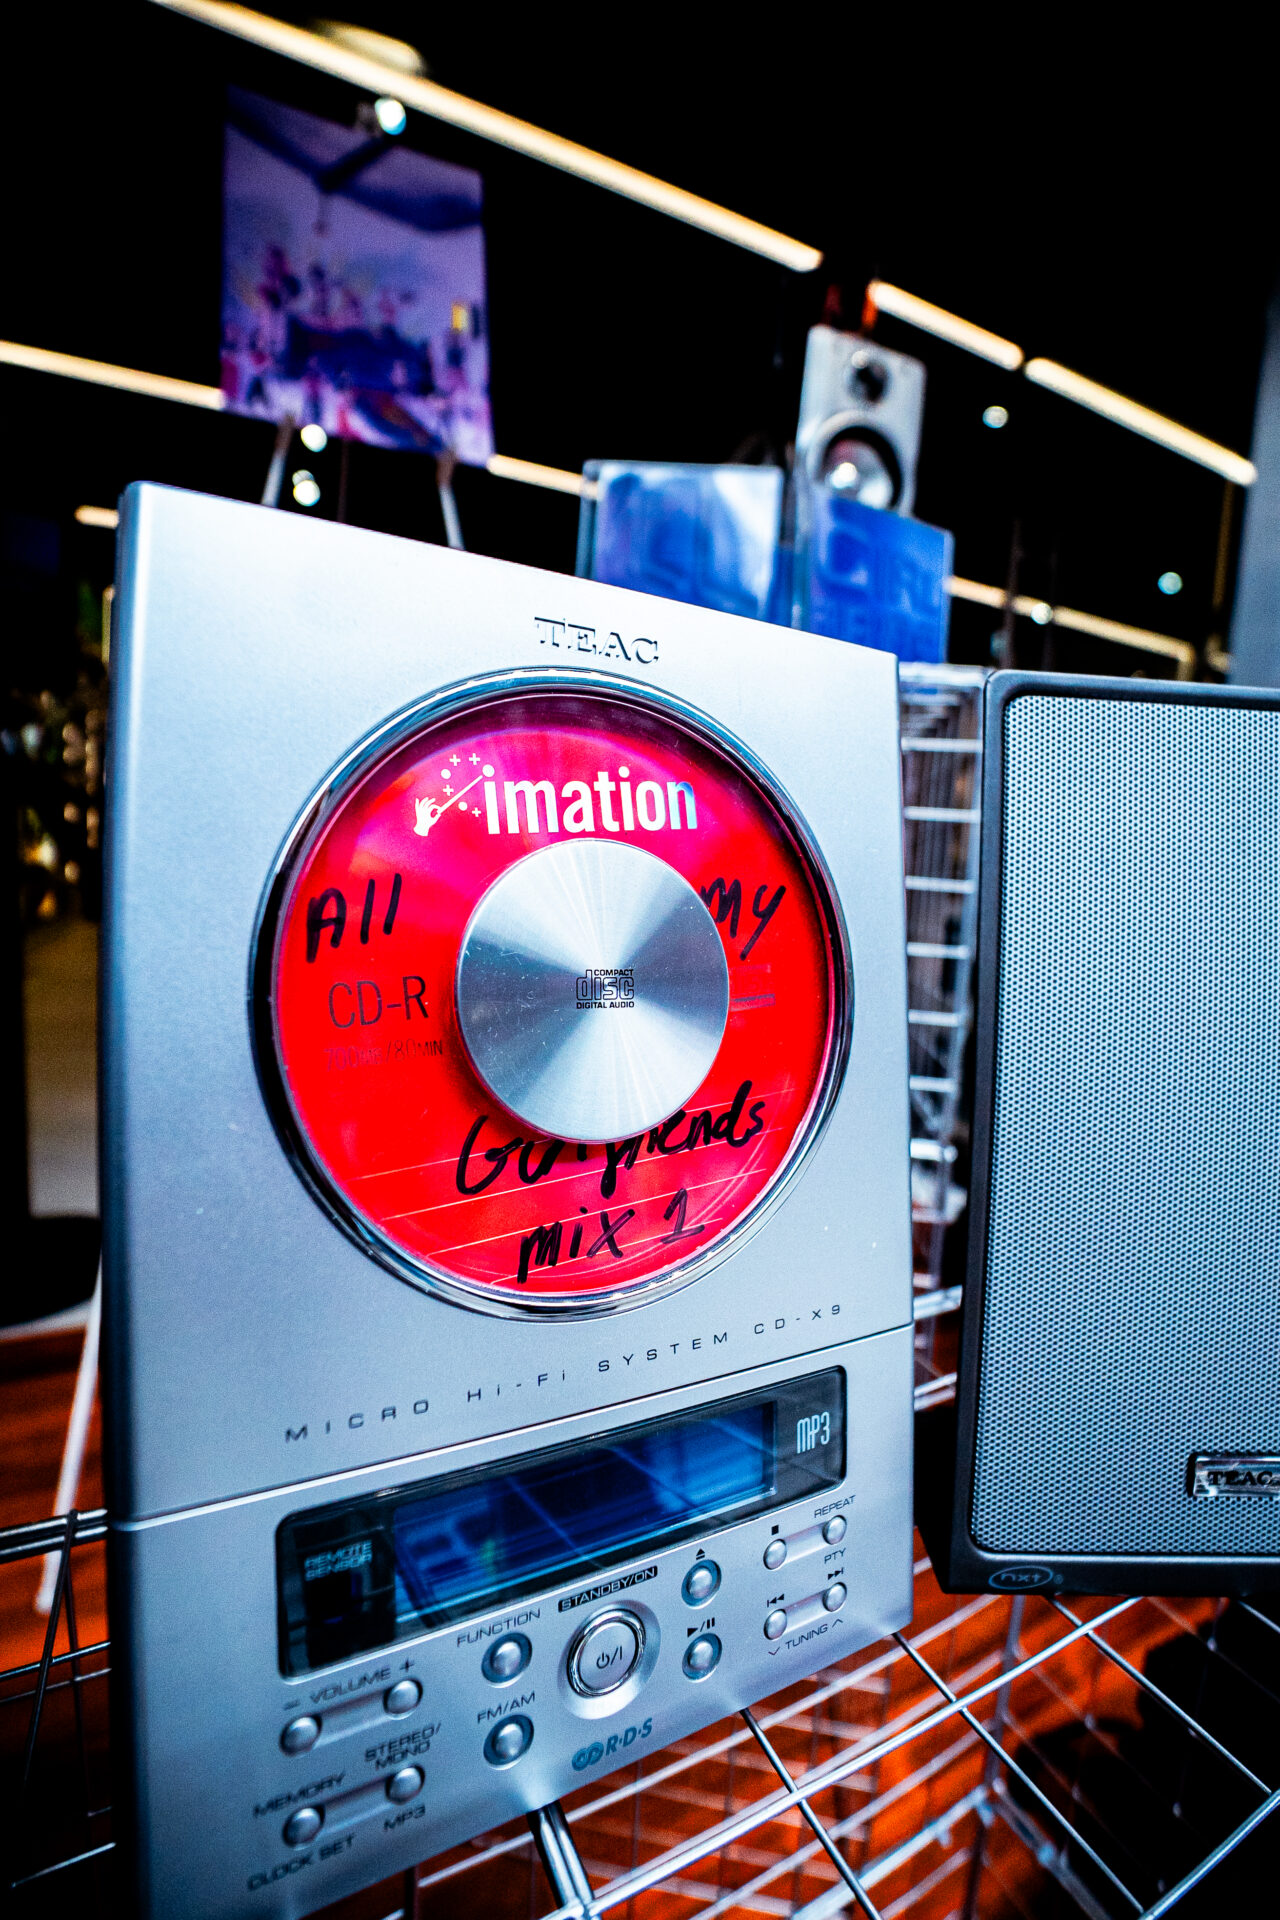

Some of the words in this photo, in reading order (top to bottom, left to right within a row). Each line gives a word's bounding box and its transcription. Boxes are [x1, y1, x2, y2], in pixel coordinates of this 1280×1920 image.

[534, 617, 660, 665] TEAC
[484, 766, 698, 835] imation
[306, 873, 402, 964] All
[594, 969, 634, 977] COMPACT
[328, 975, 429, 1029] CD-R
[576, 1002, 607, 1010] DIGITAL
[609, 1001, 635, 1009] AUDIO
[661, 1188, 705, 1244] 1
[285, 1399, 430, 1444] MICRO
[467, 1367, 567, 1402] Hi-Fi
[597, 1331, 729, 1373] SYSTEM
[753, 1304, 842, 1336] CD-X9
[797, 1411, 830, 1454] MP3
[1208, 1470, 1273, 1486] TEAC
[813, 1495, 856, 1519] REPEAT
[824, 1548, 847, 1564] PTY
[561, 1568, 656, 1611] STANDBY/ON
[456, 1608, 541, 1648] FUNCTION
[785, 1623, 828, 1651] TUNING
[310, 1667, 391, 1704] VOLUME
[477, 1692, 536, 1725] FM/AM
[375, 1741, 430, 1770] MONO
[253, 1772, 345, 1819] MEMORY
[384, 1805, 426, 1832] MP3
[248, 1858, 314, 1892] CLOCK
[318, 1834, 354, 1858] SET
